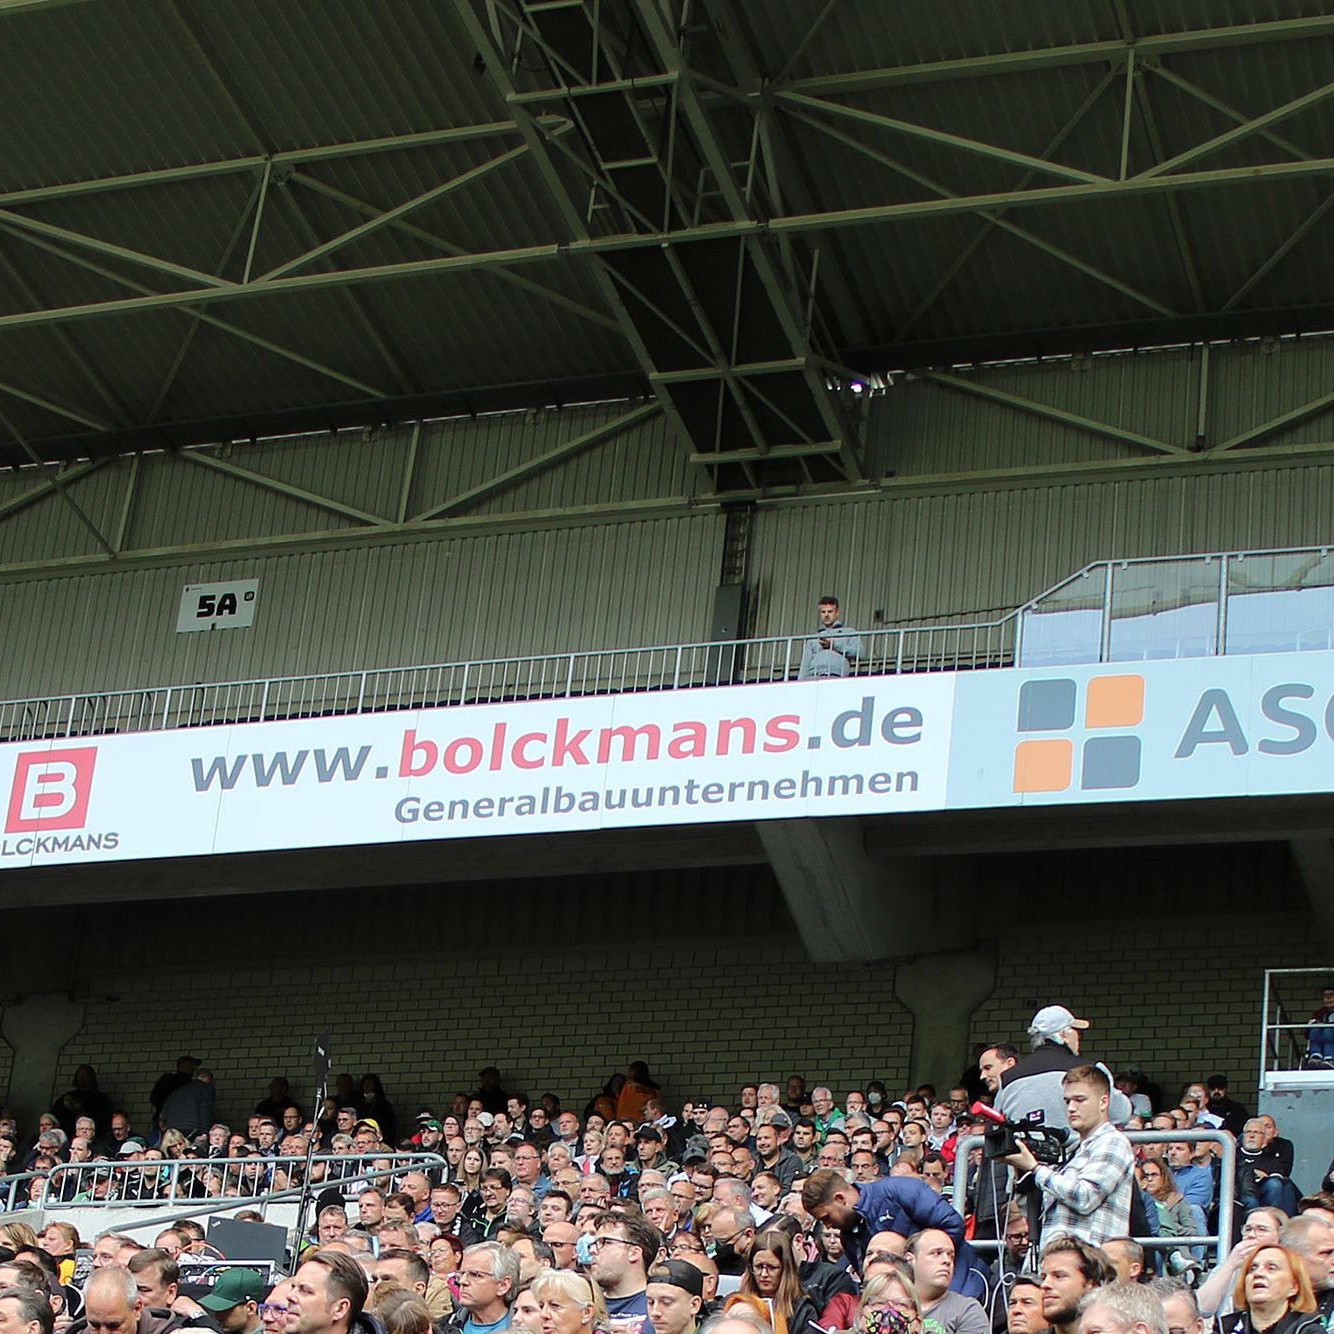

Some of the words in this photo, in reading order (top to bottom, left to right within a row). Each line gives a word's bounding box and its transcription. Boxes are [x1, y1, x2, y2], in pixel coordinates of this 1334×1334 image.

[196, 593, 237, 618] 5A
[190, 695, 924, 792] www.bolckmans.de
[394, 769, 919, 824] Generalbauunternehmen
